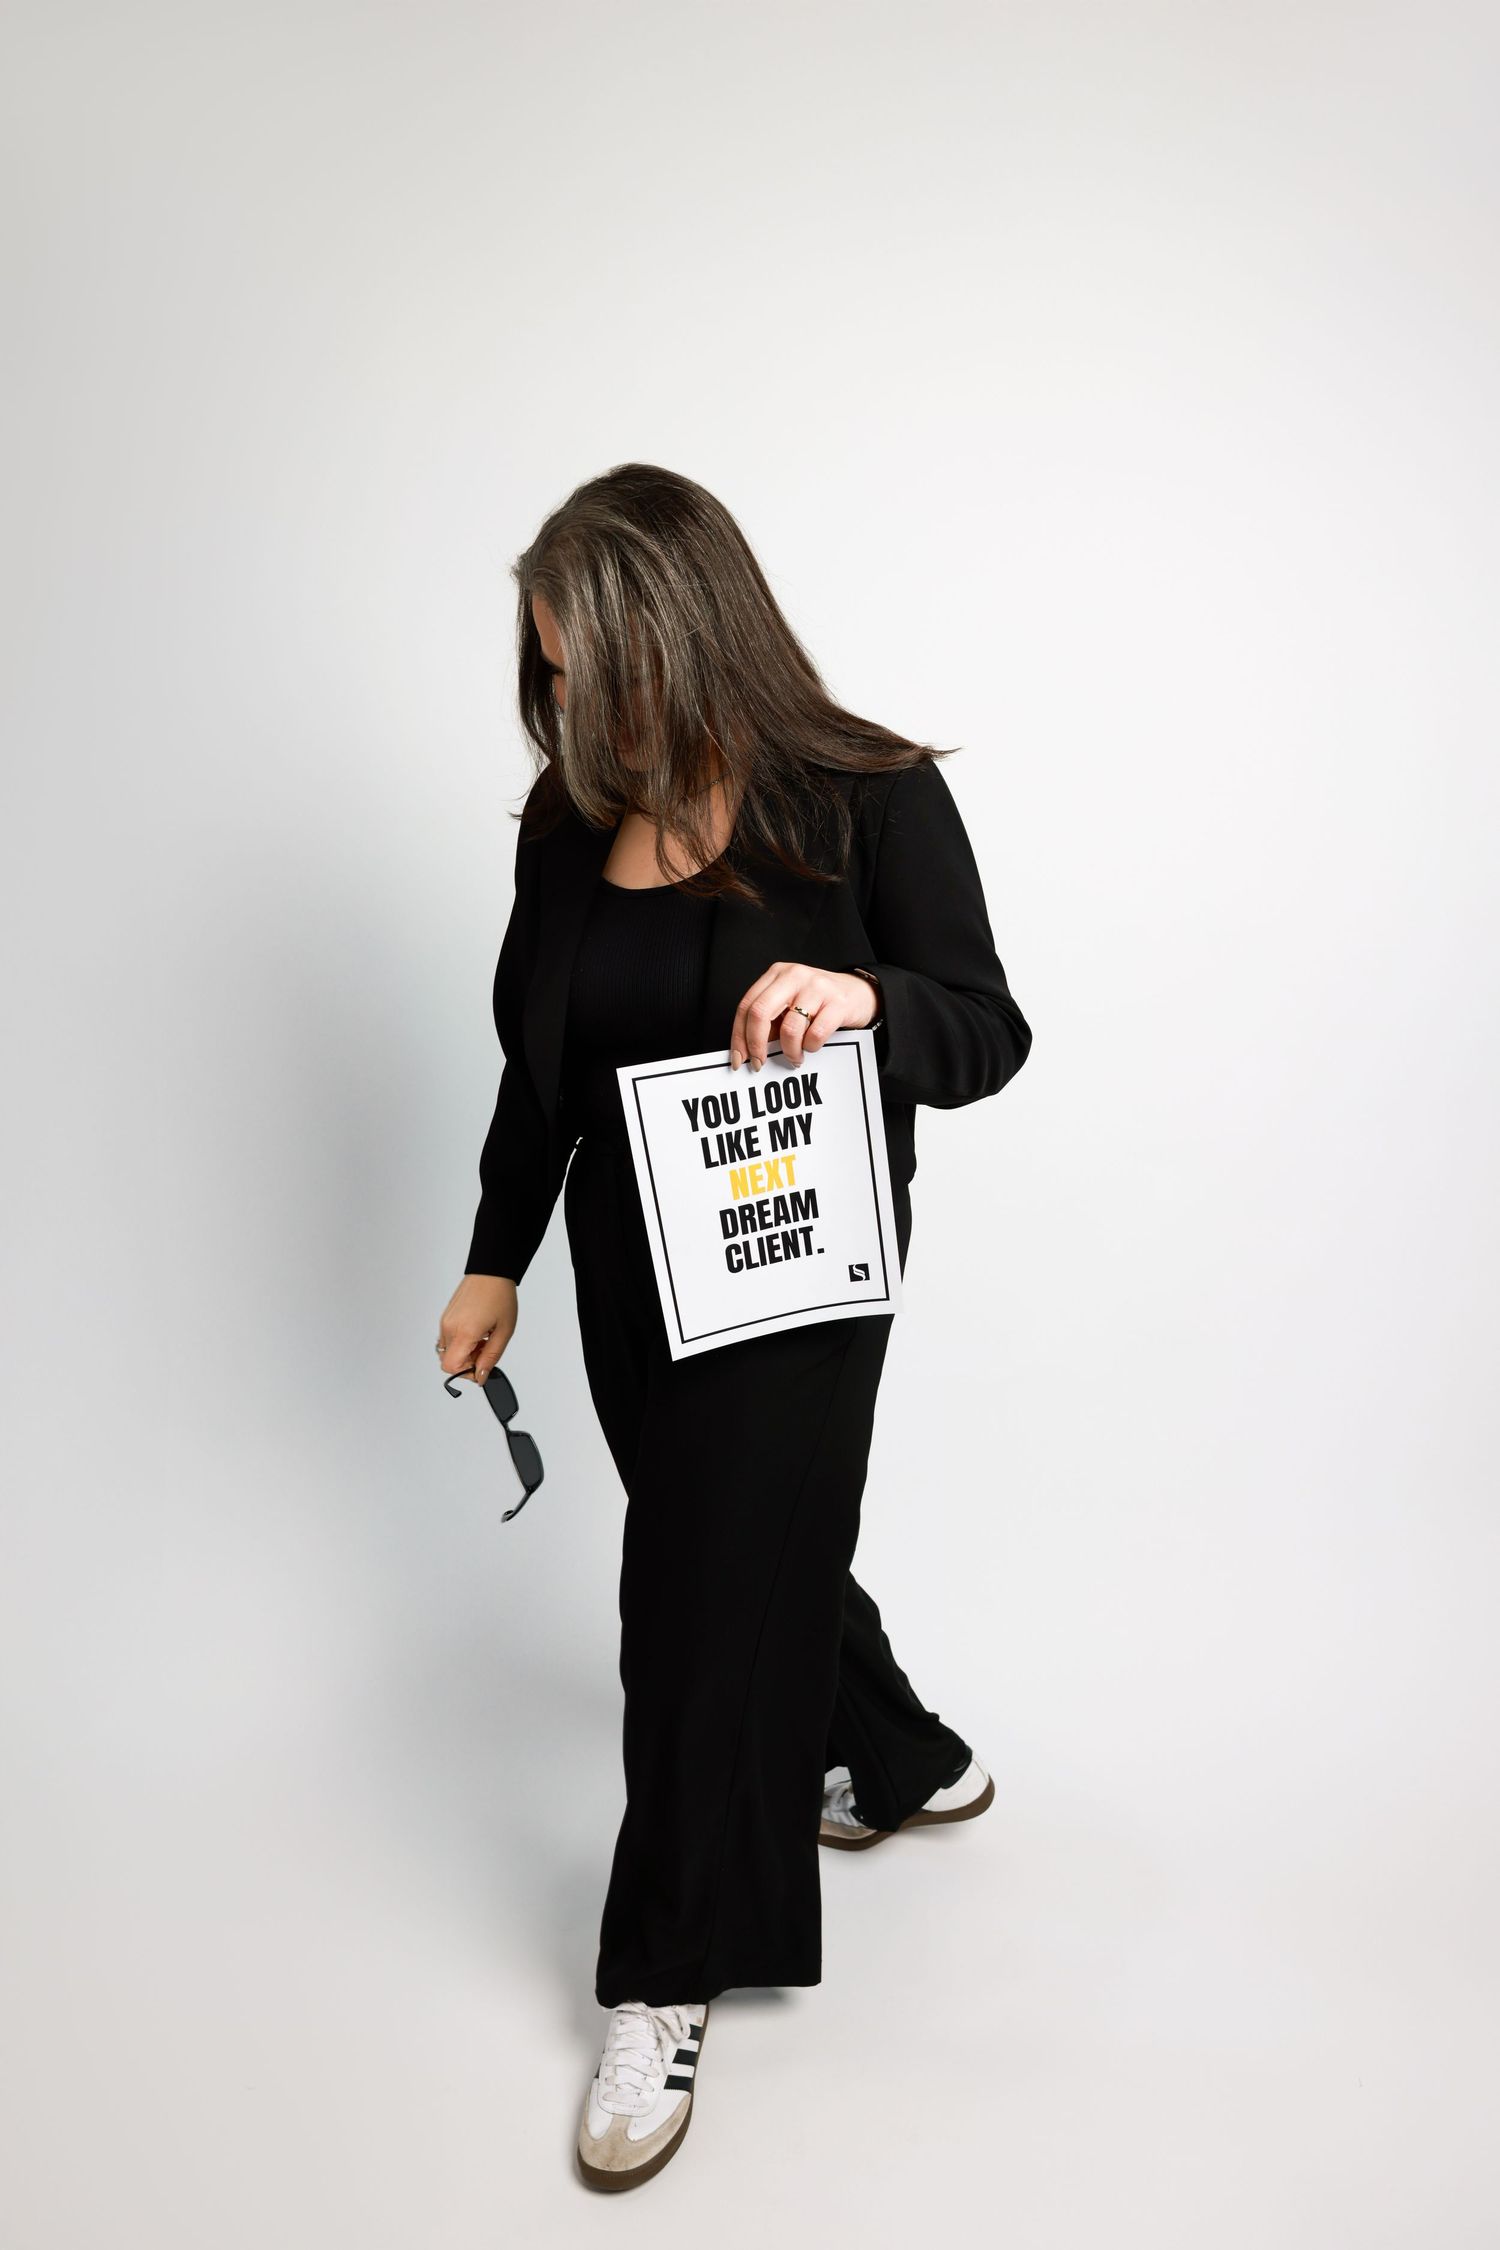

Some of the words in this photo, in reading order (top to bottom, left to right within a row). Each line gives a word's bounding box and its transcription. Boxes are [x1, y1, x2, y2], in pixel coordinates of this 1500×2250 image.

[681, 1090, 741, 1133] YOU
[748, 1072, 823, 1120] LOOK
[700, 1125, 762, 1170] LIKE
[767, 1112, 813, 1153] MY
[729, 1153, 797, 1201] NEXT
[718, 1188, 820, 1240] DREAM
[724, 1225, 825, 1274] CLIENT.
